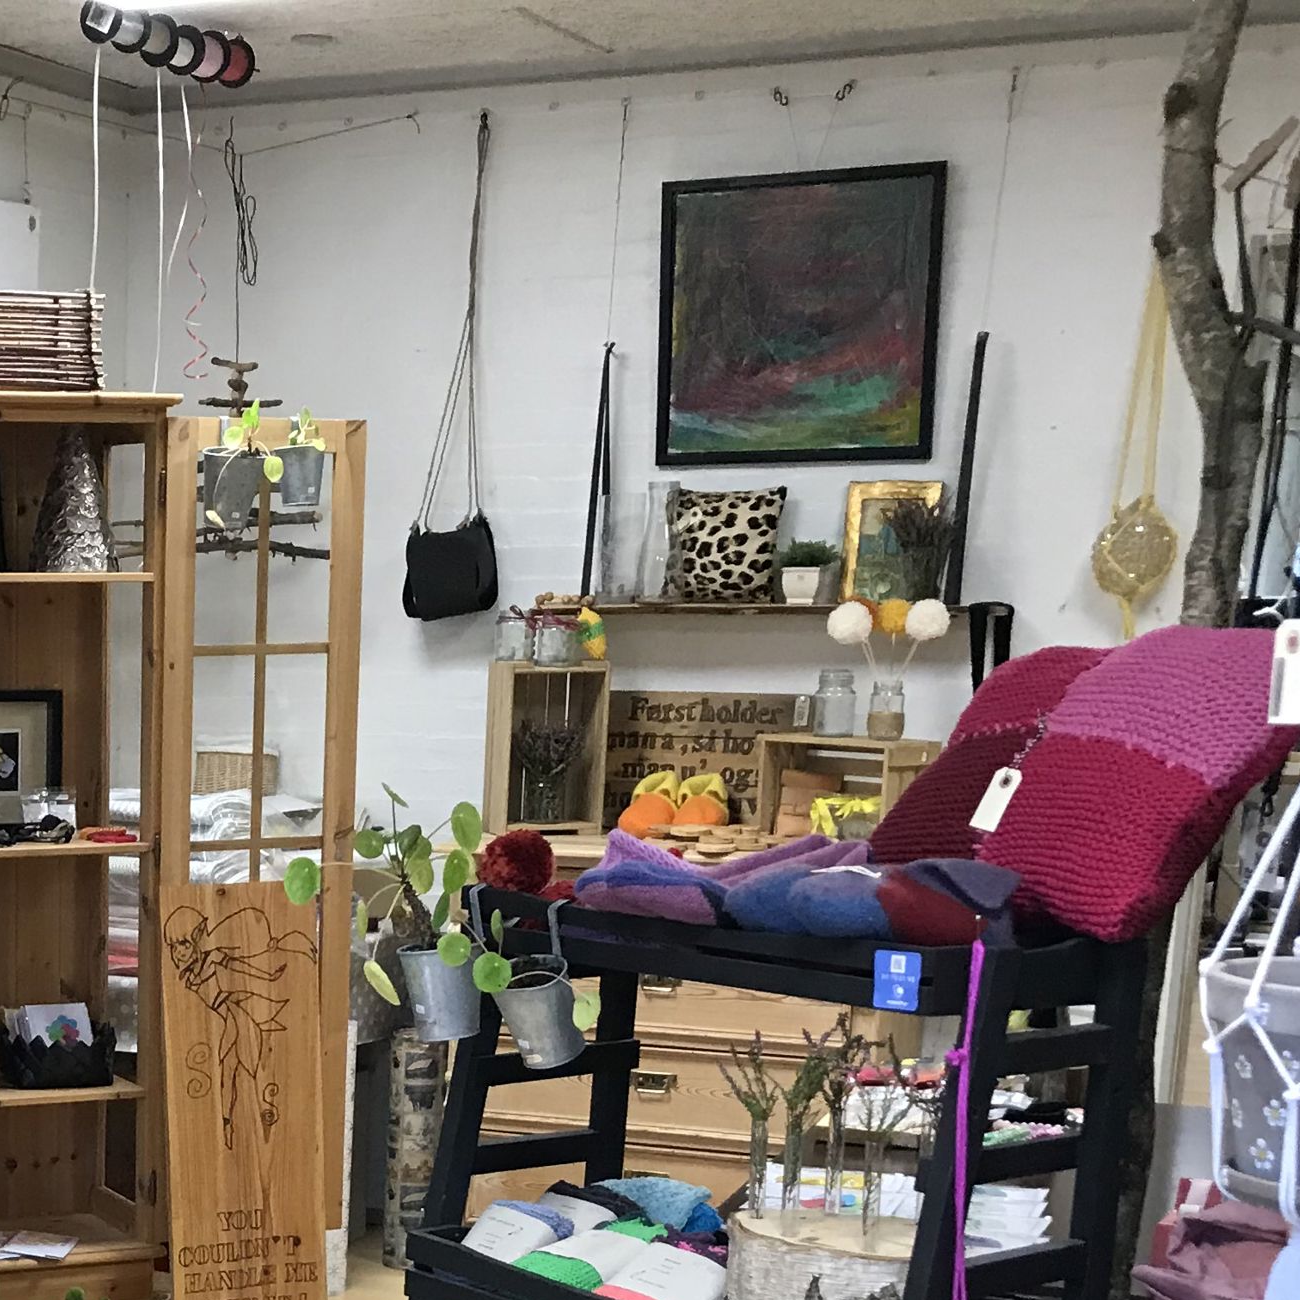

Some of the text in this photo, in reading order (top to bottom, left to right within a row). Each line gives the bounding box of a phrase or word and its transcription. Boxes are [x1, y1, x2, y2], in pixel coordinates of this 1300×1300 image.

[699, 697, 783, 725] holder
[217, 1209, 263, 1231] YOU
[184, 1262, 318, 1294] HANDLE ME
